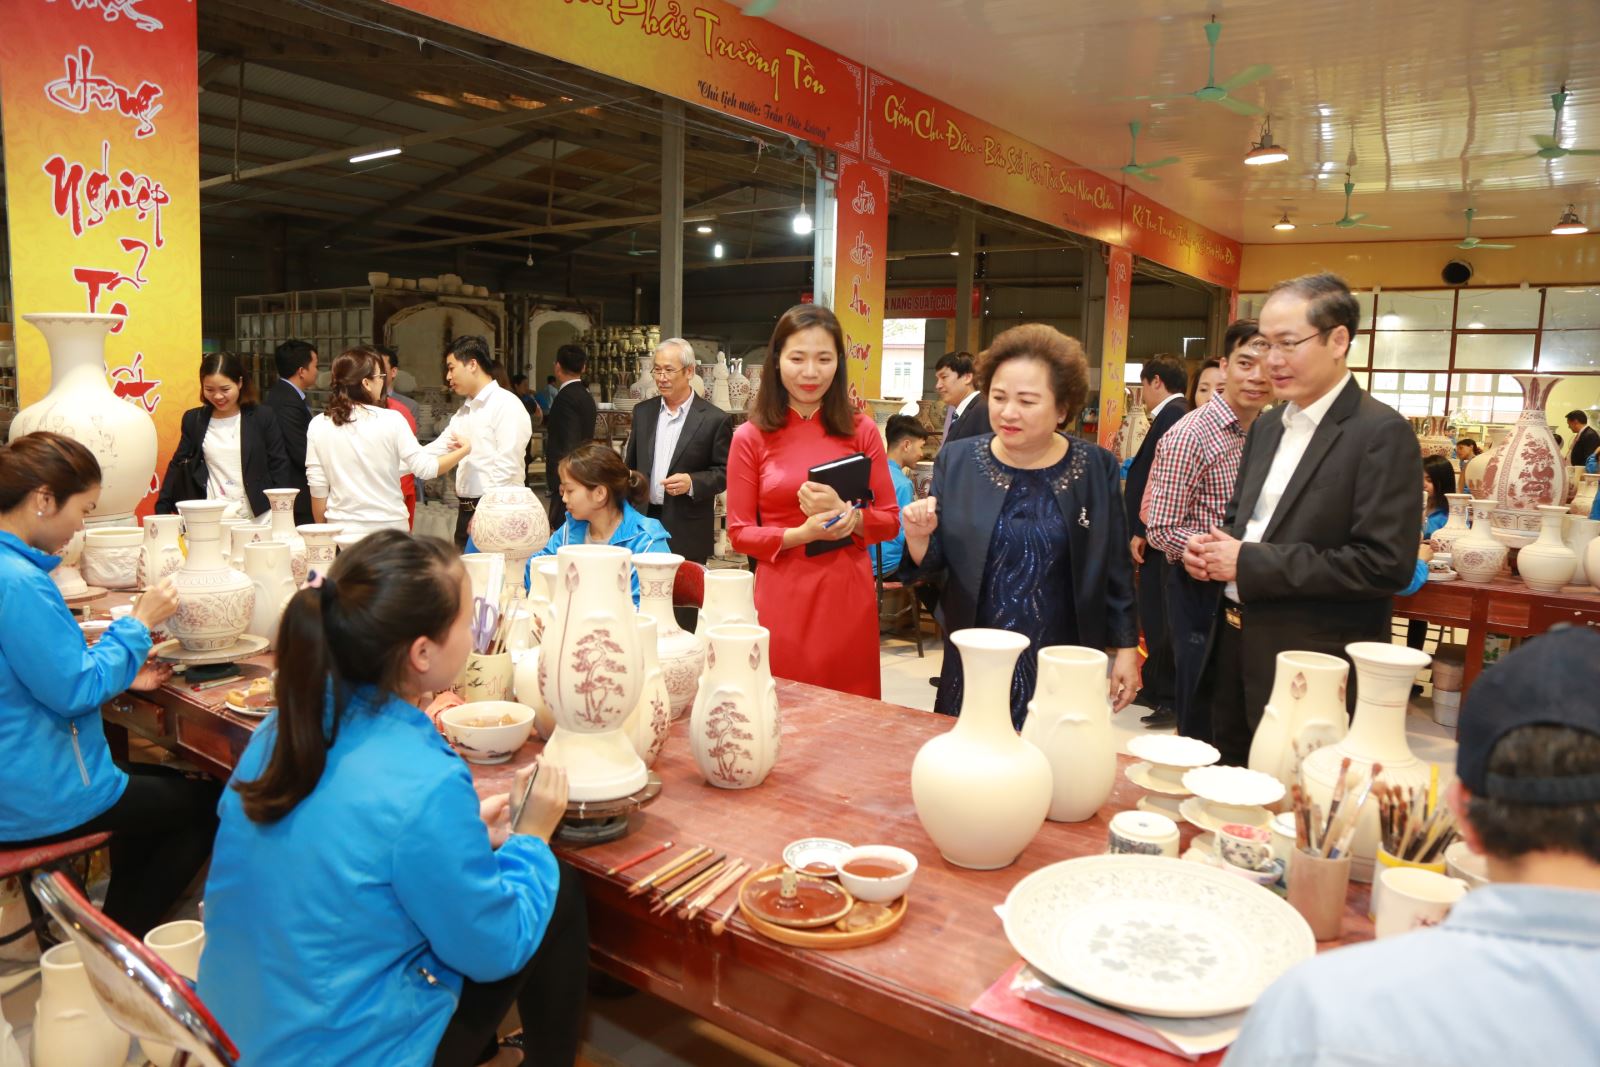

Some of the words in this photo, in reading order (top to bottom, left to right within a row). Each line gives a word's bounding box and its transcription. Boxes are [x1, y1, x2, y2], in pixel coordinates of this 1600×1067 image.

[694, 7, 780, 101] Trường
[785, 47, 827, 95] Tồn
[884, 95, 914, 135] Gốm
[915, 108, 944, 141] Chu
[43, 140, 170, 248] Nghiệp
